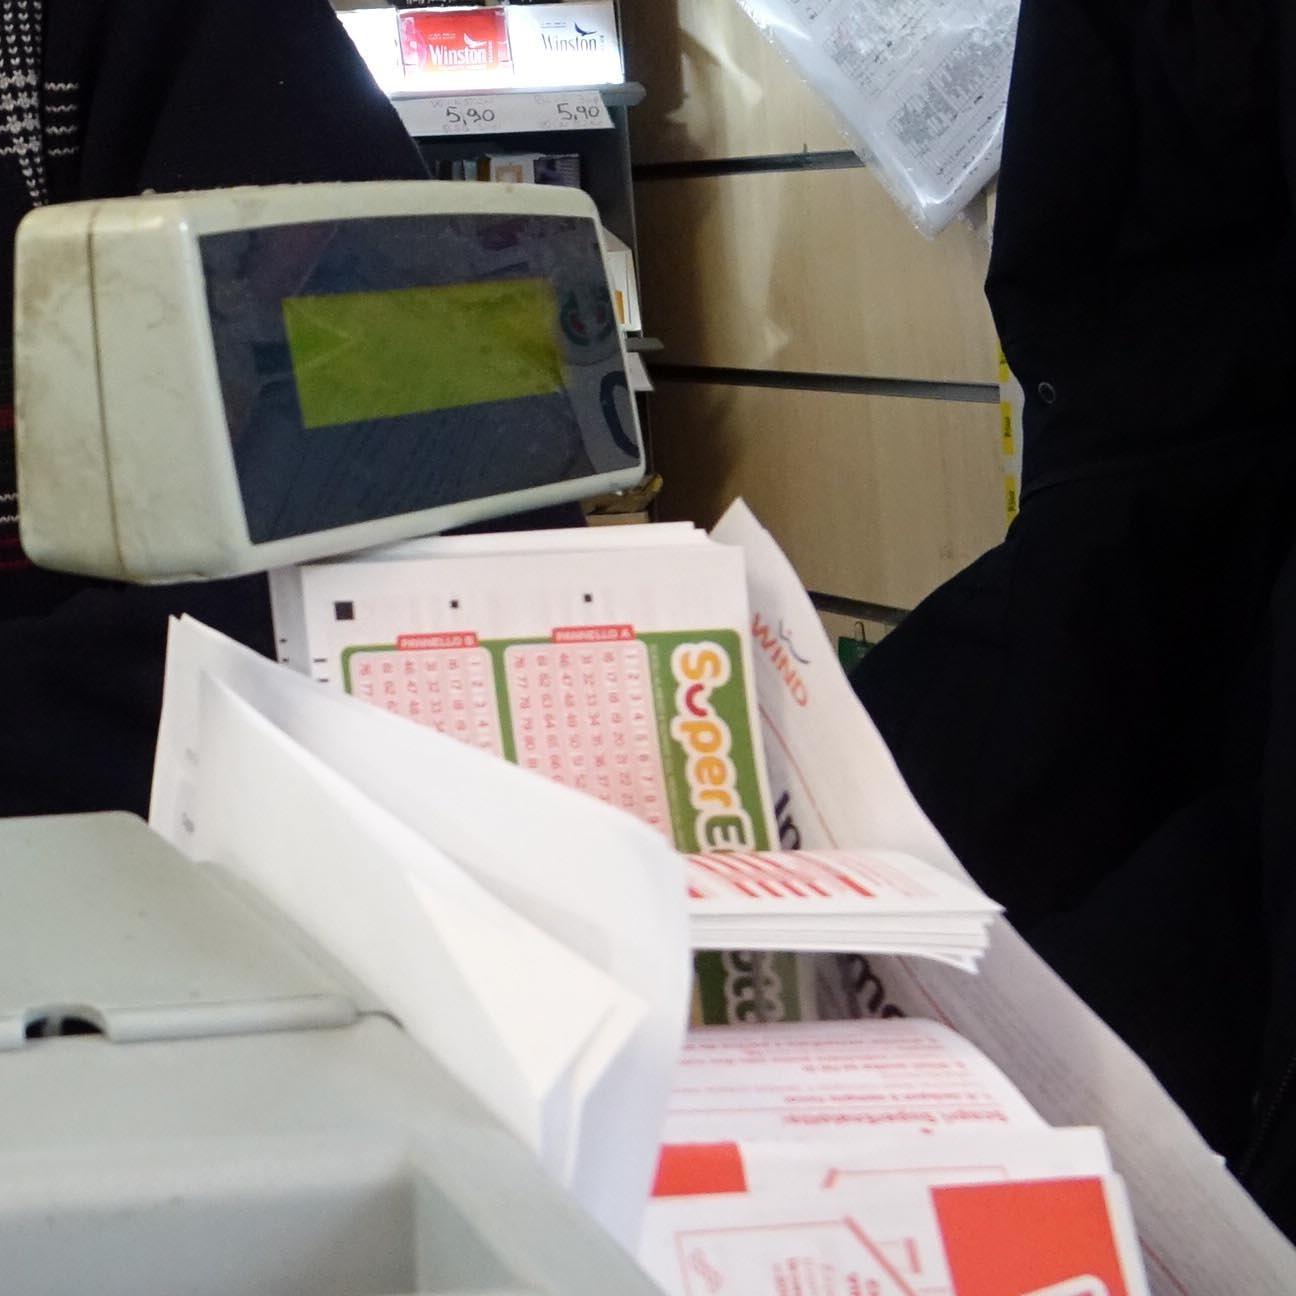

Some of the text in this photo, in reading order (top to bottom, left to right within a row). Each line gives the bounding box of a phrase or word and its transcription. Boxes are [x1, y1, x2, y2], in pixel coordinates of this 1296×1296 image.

[428, 43, 487, 65] Winston
[752, 613, 808, 706] WIND
[680, 649, 748, 853] SuperE
